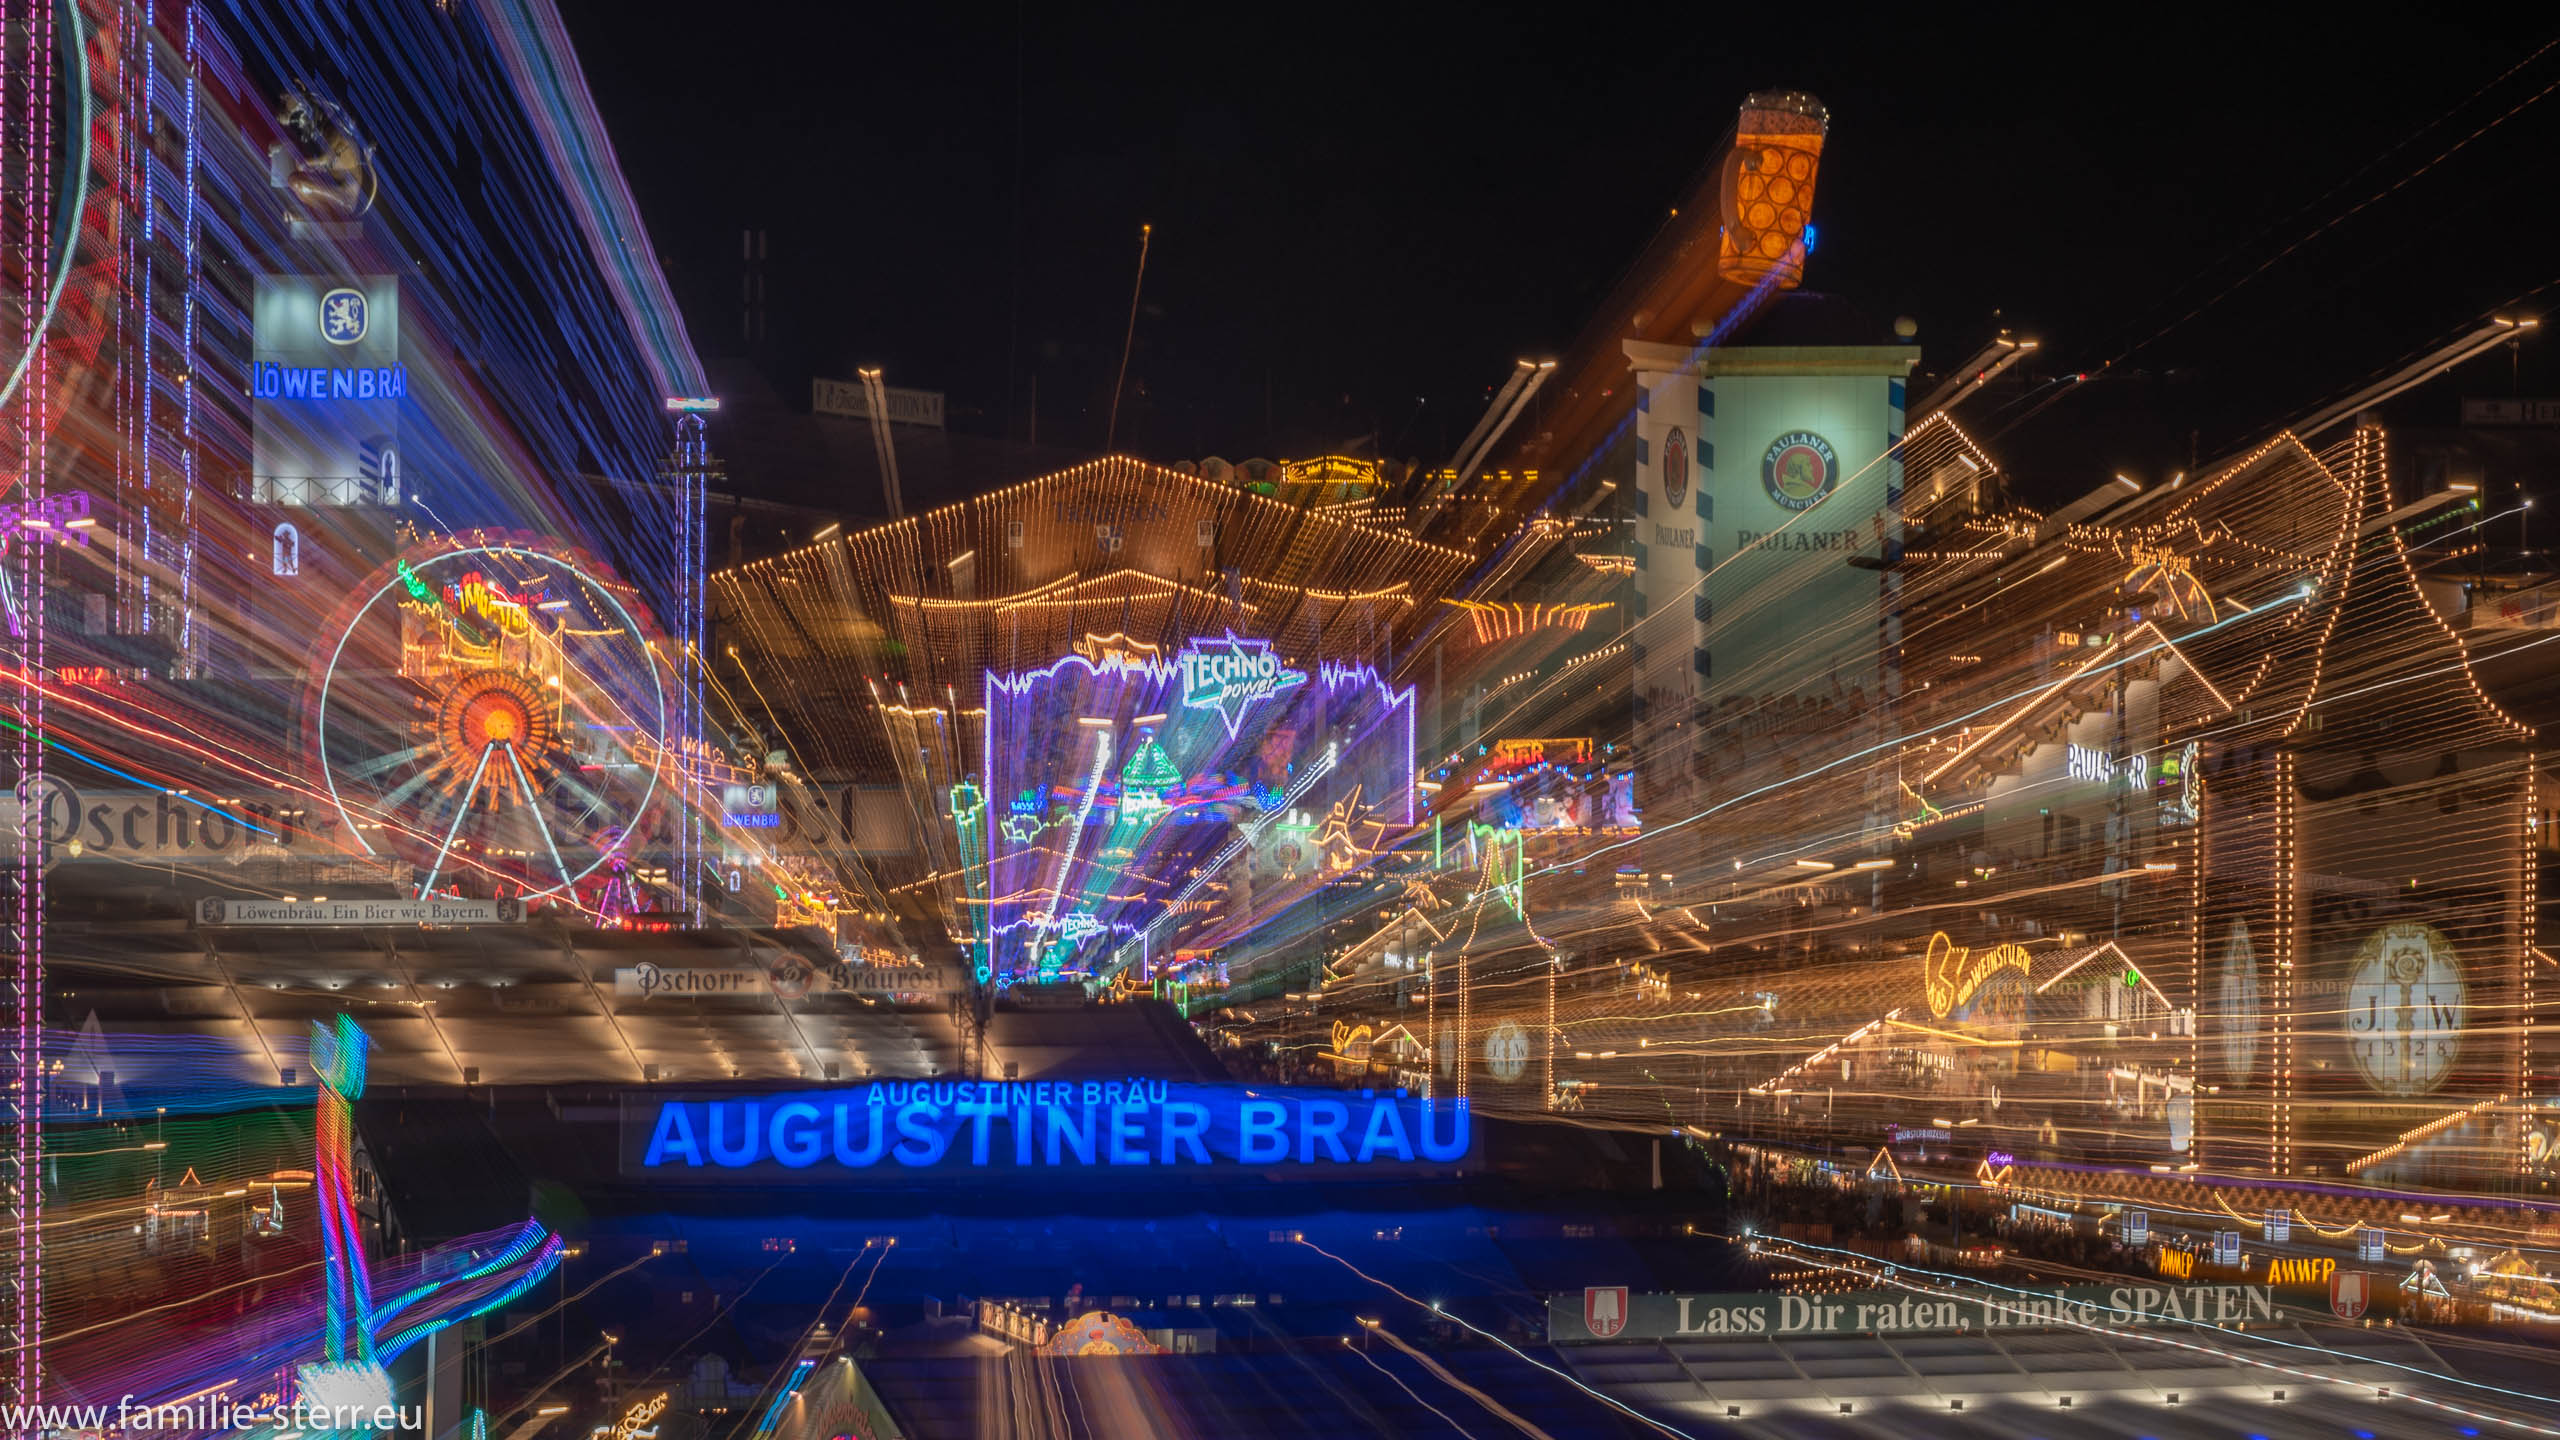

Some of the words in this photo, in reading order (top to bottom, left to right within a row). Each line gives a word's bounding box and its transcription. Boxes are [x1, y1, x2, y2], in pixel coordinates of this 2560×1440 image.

[1766, 432, 1834, 463] PAULANER
[1655, 523, 1695, 549] PAULANER
[1737, 528, 1859, 551] PAULANER
[1183, 642, 1276, 692] TECHNO
[1218, 676, 1278, 704] power
[2067, 743, 2148, 790] PAULAR
[236, 904, 328, 920] Löwenbräu.
[333, 904, 358, 919] Ein
[364, 904, 395, 919] Bier
[401, 903, 427, 918] wie
[432, 904, 489, 922] Bayern.
[866, 1082, 1073, 1107] AUGUSTINER
[1082, 1077, 1169, 1106] BRÄU
[643, 1101, 1213, 1168] AUGUSTINER
[1239, 1087, 1472, 1164] BRÄU
[1676, 1297, 1766, 1334] Lass
[1777, 1293, 1844, 1332] Dir
[1856, 1296, 1970, 1331] raten,
[1983, 1290, 2099, 1328] trinke
[2109, 1284, 2285, 1325] SPATEN.
